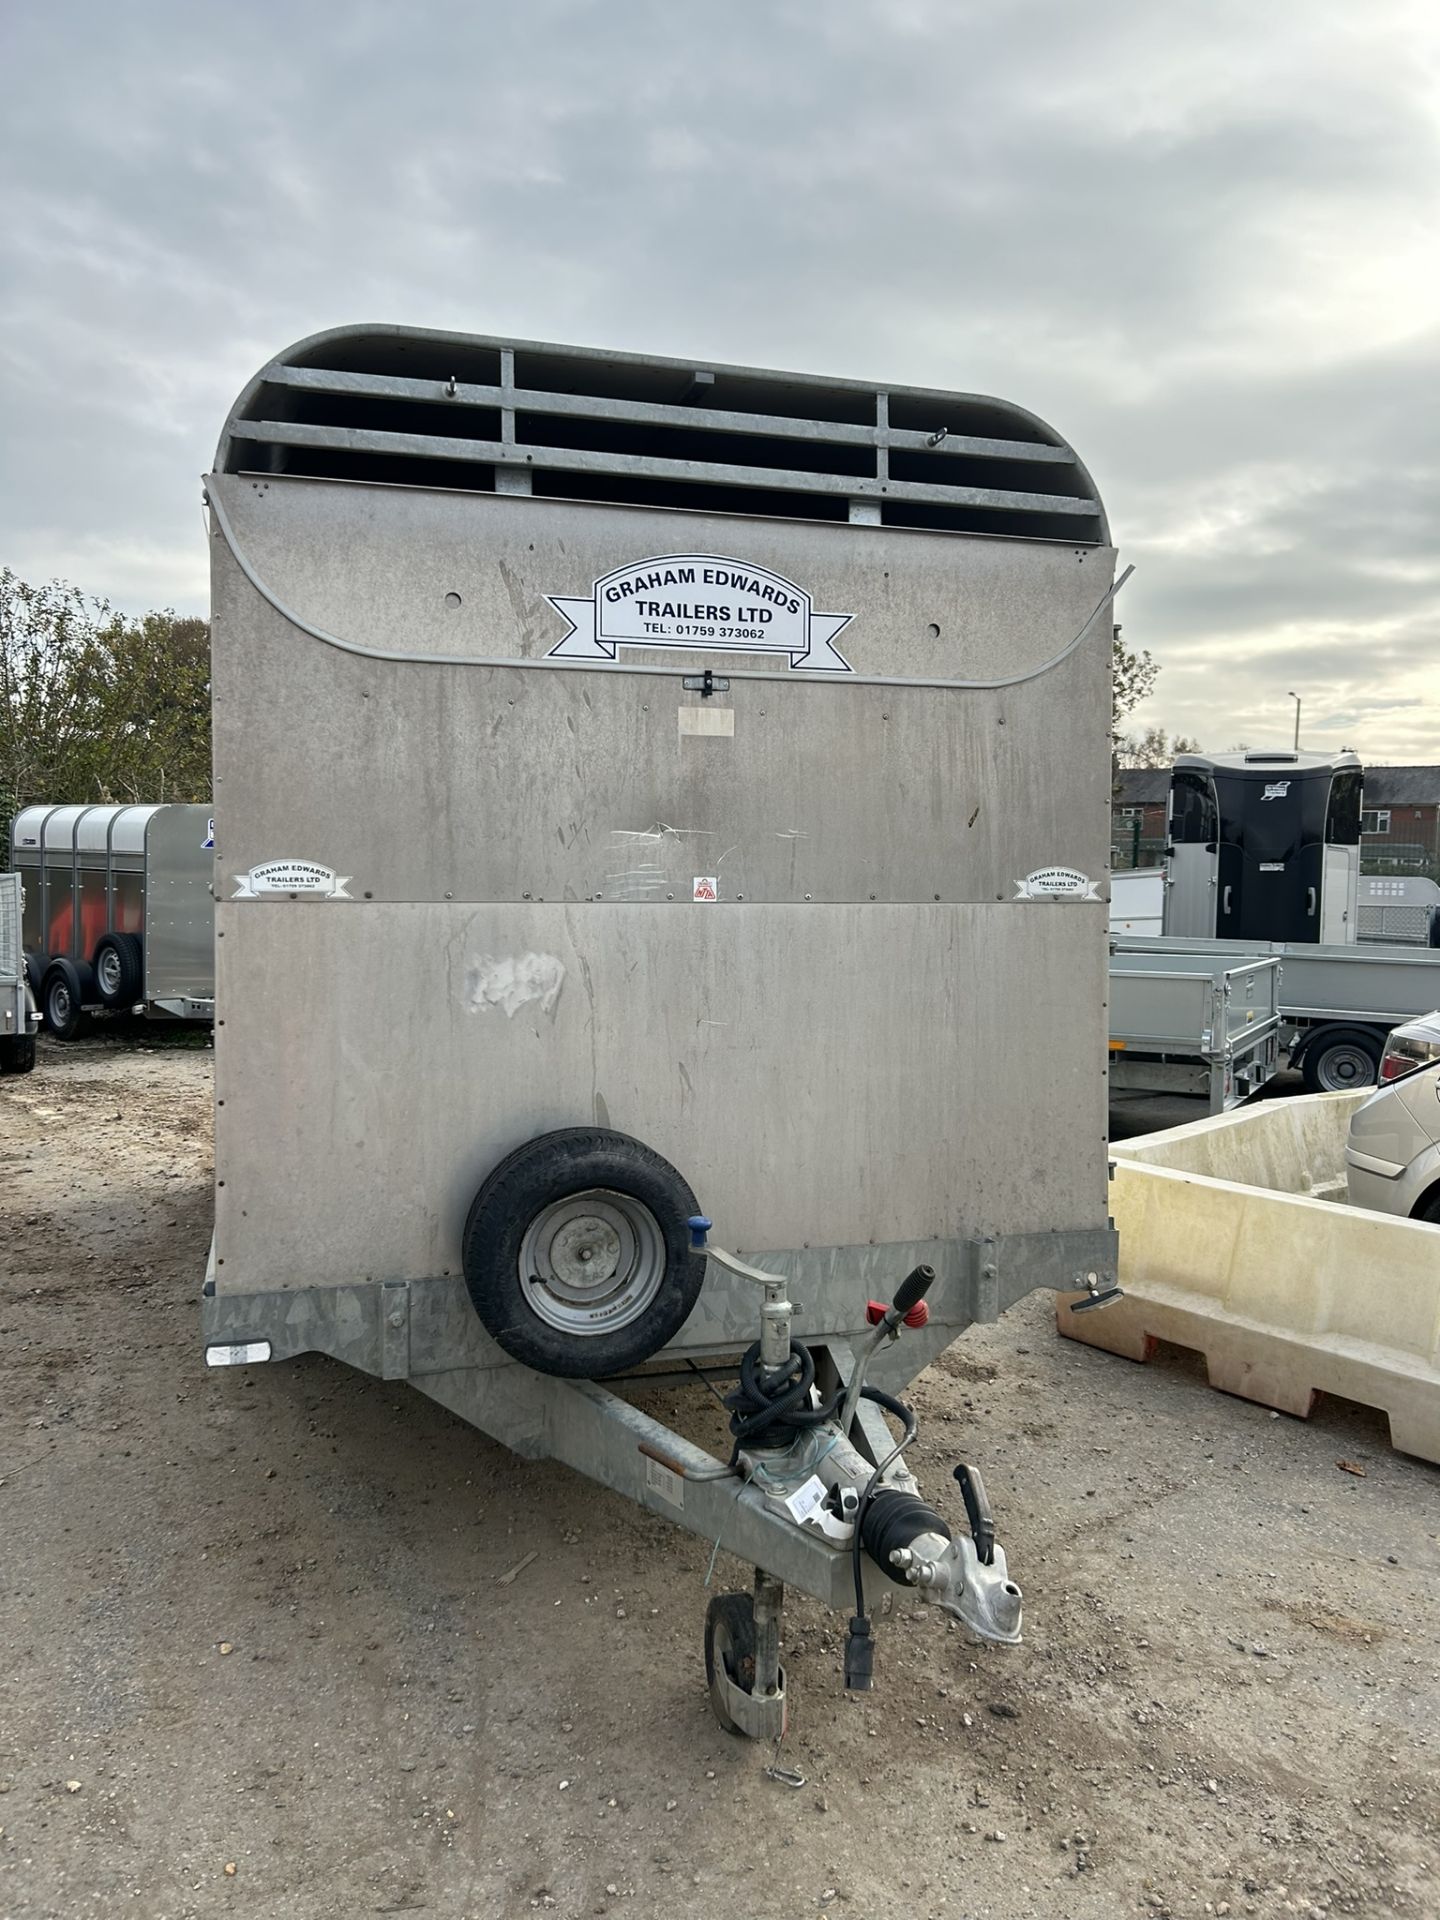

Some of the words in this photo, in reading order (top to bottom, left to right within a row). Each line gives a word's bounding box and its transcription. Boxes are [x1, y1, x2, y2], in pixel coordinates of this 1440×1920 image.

[605, 568, 696, 603] GRAHAM
[703, 568, 801, 614] EDWARDS
[635, 600, 731, 621] TRAILERS
[738, 607, 773, 624] LTD
[643, 622, 671, 634] TEL:
[676, 624, 715, 637] 01759
[719, 627, 765, 639] 373062
[254, 865, 289, 879] GRAHAM
[291, 865, 331, 879] EDWARDS
[1030, 871, 1055, 883] GRAHAM
[1057, 871, 1085, 884] EDWARDS
